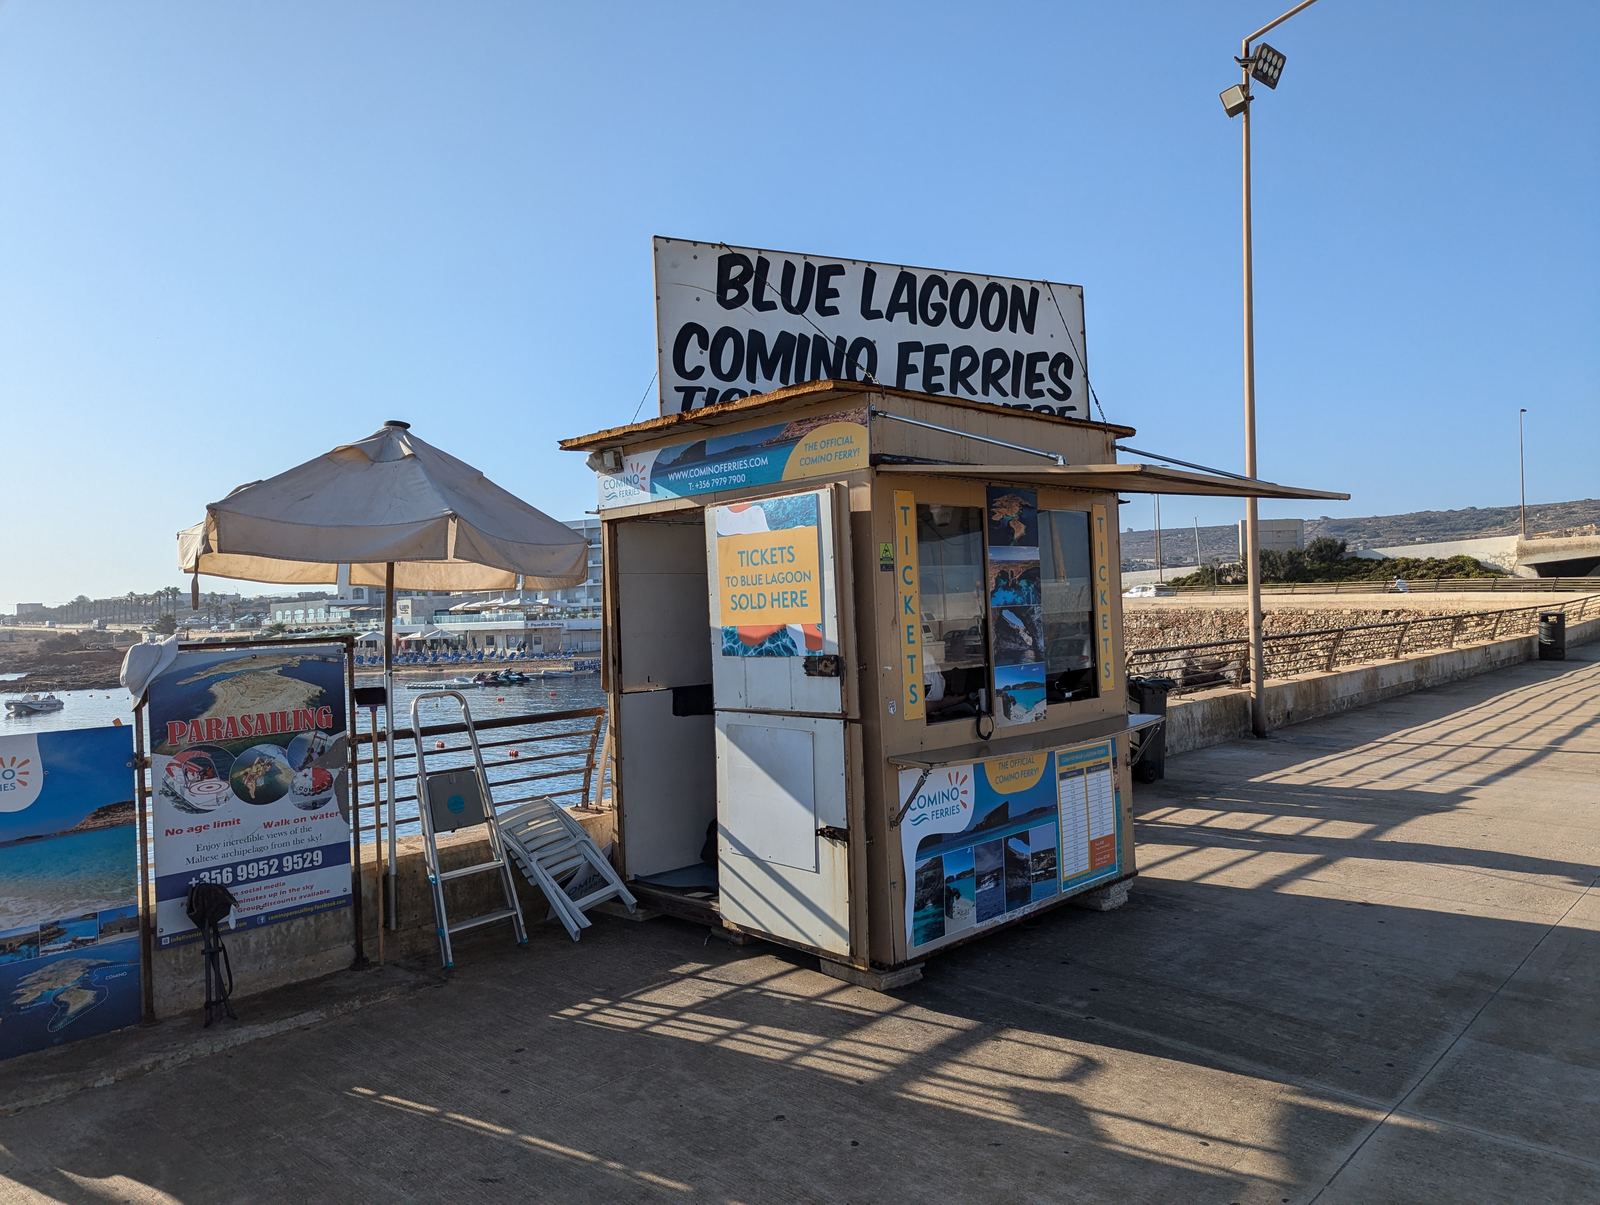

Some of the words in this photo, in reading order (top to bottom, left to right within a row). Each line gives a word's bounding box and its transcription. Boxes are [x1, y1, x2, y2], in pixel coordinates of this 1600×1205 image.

[717, 253, 846, 319] BLUE
[860, 266, 1040, 335] LAGOON
[672, 321, 879, 385] COMINO
[896, 341, 1074, 401] FERRIES
[803, 441, 818, 451] THE
[819, 435, 854, 449] OFFICIAL
[800, 452, 832, 467] COMINO
[833, 448, 861, 462] FERRY!
[668, 456, 768, 481] WWW.COMINOFERRIES.COM
[603, 473, 640, 490] COMINO
[695, 480, 710, 490] +356
[711, 476, 727, 488] 7979
[728, 473, 746, 485] 7900
[618, 488, 641, 498] FERRIES
[738, 545, 796, 567] TICKETS
[725, 575, 739, 588] TO
[740, 573, 764, 586] BLUE
[765, 570, 811, 585] LAGOON
[730, 592, 767, 611] SOLD
[771, 590, 809, 609] HERE
[900, 506, 918, 705] TICKETS
[1097, 516, 1111, 679] TICKETS
[166, 705, 333, 745] PARASAILING
[998, 760, 1009, 770] THE
[1009, 757, 1035, 769] OFFICIAL
[995, 773, 1019, 785] COMINO
[909, 786, 960, 812] COMINO
[262, 816, 291, 829] Walk
[292, 815, 307, 825] on
[310, 811, 340, 822] water
[931, 804, 961, 821] FERRIES
[164, 827, 184, 837] No
[187, 824, 210, 836] age
[213, 817, 241, 829] limit
[196, 841, 221, 853] Enjoy
[223, 833, 265, 847] incredible
[266, 830, 287, 840] views
[289, 826, 299, 836] of
[299, 825, 312, 834] the
[185, 854, 219, 866] Maltese
[221, 845, 269, 860] archipelago
[271, 839, 291, 850] from
[292, 836, 305, 845] the
[307, 834, 323, 844] sky!
[188, 868, 233, 887] +356
[236, 857, 279, 882] 9952
[282, 850, 323, 871] 9529
[240, 885, 262, 895] social
[264, 881, 286, 891] media
[268, 892, 278, 900] up
[302, 884, 314, 893] sky
[237, 903, 261, 914] Group
[260, 896, 297, 909] discounts
[299, 889, 331, 900] available
